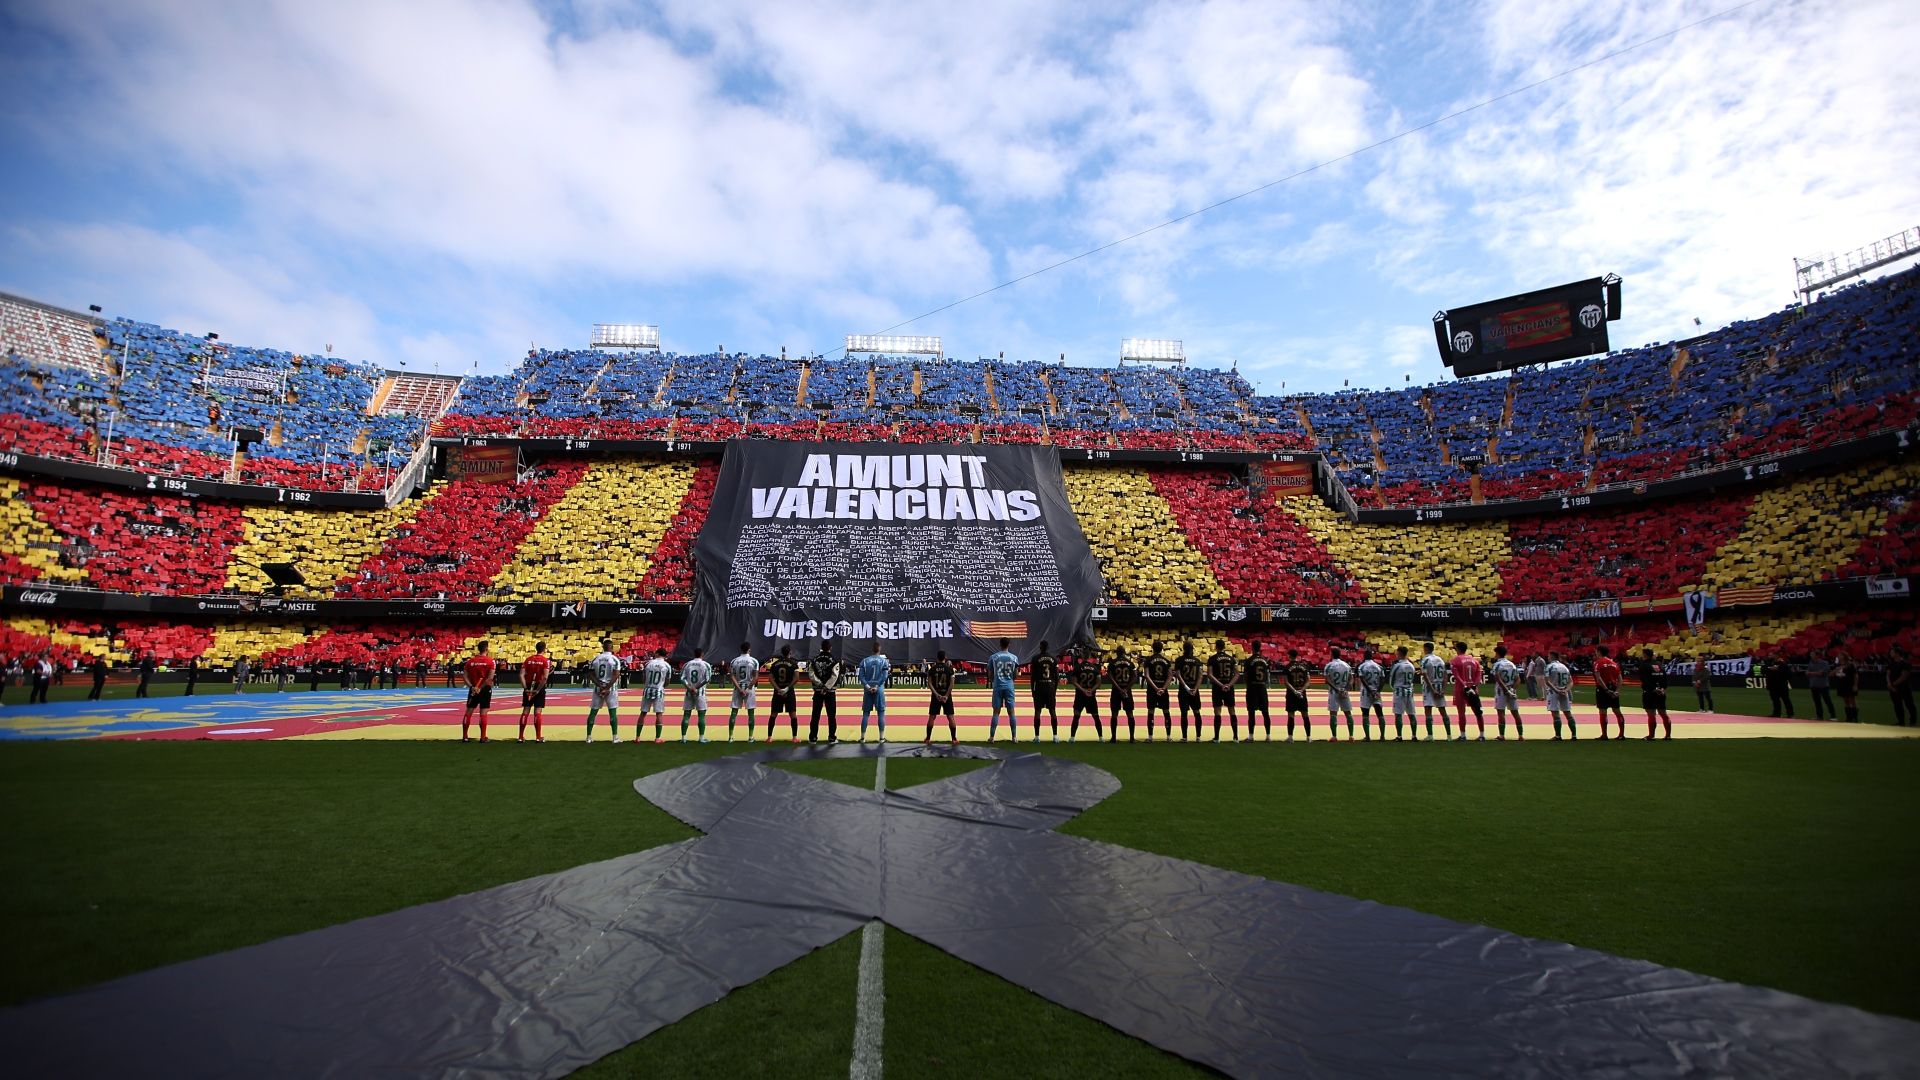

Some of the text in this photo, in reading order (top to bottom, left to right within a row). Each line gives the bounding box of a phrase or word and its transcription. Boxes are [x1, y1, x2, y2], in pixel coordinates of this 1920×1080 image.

[1491, 315, 1561, 338] VALENCIANS
[575, 440, 590, 449] 1967
[677, 442, 691, 450] 1971
[460, 459, 504, 474] AMUNT
[798, 454, 987, 488] AMUNT
[1758, 462, 1779, 475] 2002
[163, 479, 188, 490] 1954
[1255, 476, 1308, 487] VALENCIANS
[290, 492, 310, 502] 1962
[1571, 496, 1590, 506] 1999
[751, 486, 1041, 522] VALENCIANS
[1426, 510, 1442, 518] 1999
[778, 572, 839, 580] MASSANASSA
[964, 569, 1011, 578] MACASTRE
[964, 580, 1012, 588] PICASSENT
[726, 592, 772, 602] SINARCAS
[941, 594, 987, 605] TAVERNES
[917, 588, 959, 598] SENYERA
[282, 602, 316, 611] AMSTEL
[726, 600, 768, 610] TORRENT
[781, 602, 805, 611] TOUS
[899, 601, 964, 611] VILAMARXANT
[1420, 610, 1450, 618] AMSTEL
[1502, 606, 1517, 622] LA
[1518, 604, 1551, 620] CURVA
[763, 619, 818, 640] UNITS
[876, 619, 954, 640] SEMPRE
[599, 664, 606, 678] 6
[690, 670, 698, 683] 8
[740, 666, 746, 678] 5
[778, 668, 786, 682] 9
[871, 665, 877, 681] 1
[1042, 664, 1050, 678] 3
[1156, 664, 1162, 676] 8
[1184, 666, 1196, 680] 24
[1256, 666, 1263, 680] 5
[1434, 666, 1444, 678] 16
[1466, 665, 1472, 680] 1
[650, 671, 662, 684] 10
[934, 671, 948, 684] 14
[1080, 672, 1094, 685] 22
